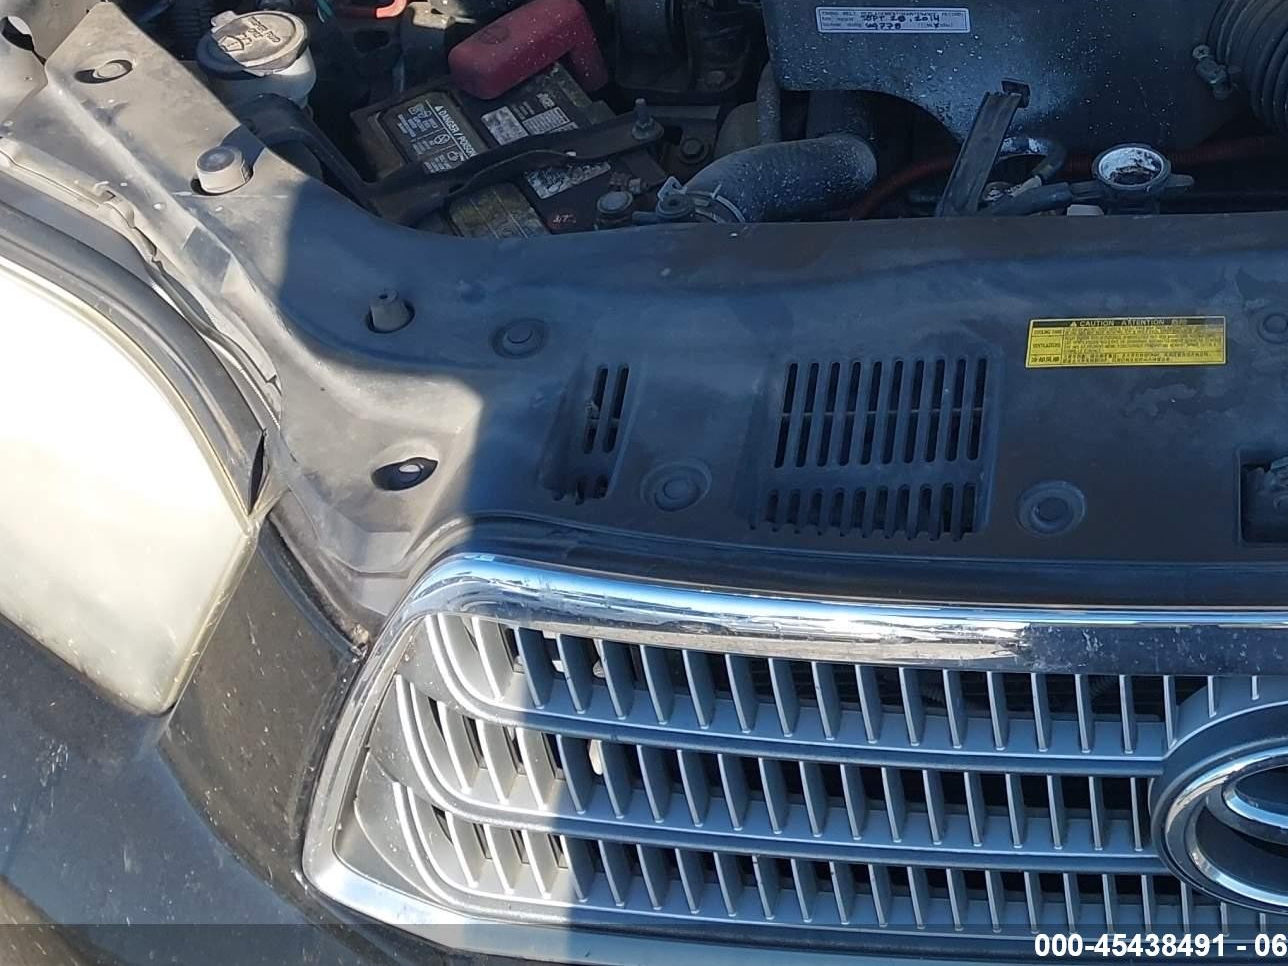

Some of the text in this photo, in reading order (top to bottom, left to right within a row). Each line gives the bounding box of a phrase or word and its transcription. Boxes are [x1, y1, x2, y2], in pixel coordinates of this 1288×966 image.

[438, 109, 460, 135] DANGER
[457, 136, 478, 158] POISON
[1079, 319, 1115, 327] CAUTION
[1121, 318, 1164, 327] ATTENTION
